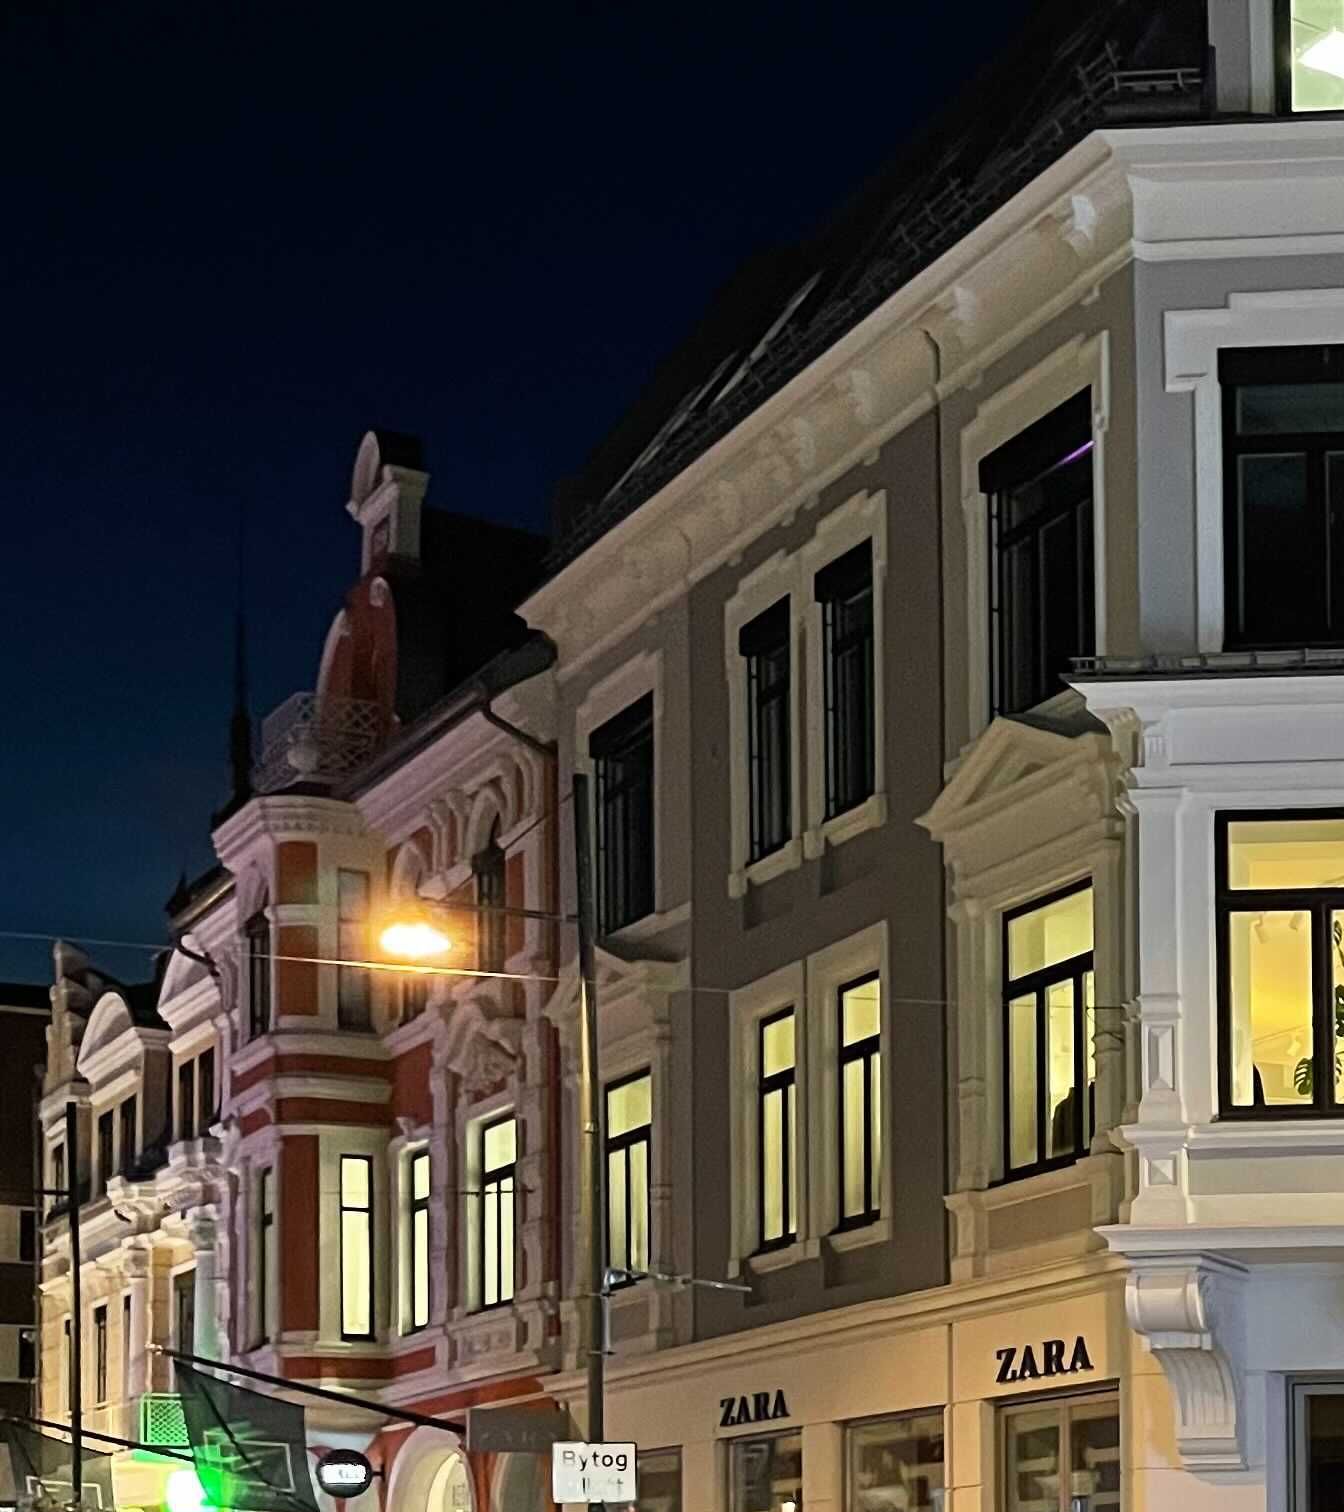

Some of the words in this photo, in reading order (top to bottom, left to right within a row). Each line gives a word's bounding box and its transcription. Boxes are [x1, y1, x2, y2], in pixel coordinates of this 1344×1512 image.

[996, 1335, 1095, 1384] ZARA
[719, 1388, 791, 1428] ZARA
[562, 1450, 628, 1471] Bytog
